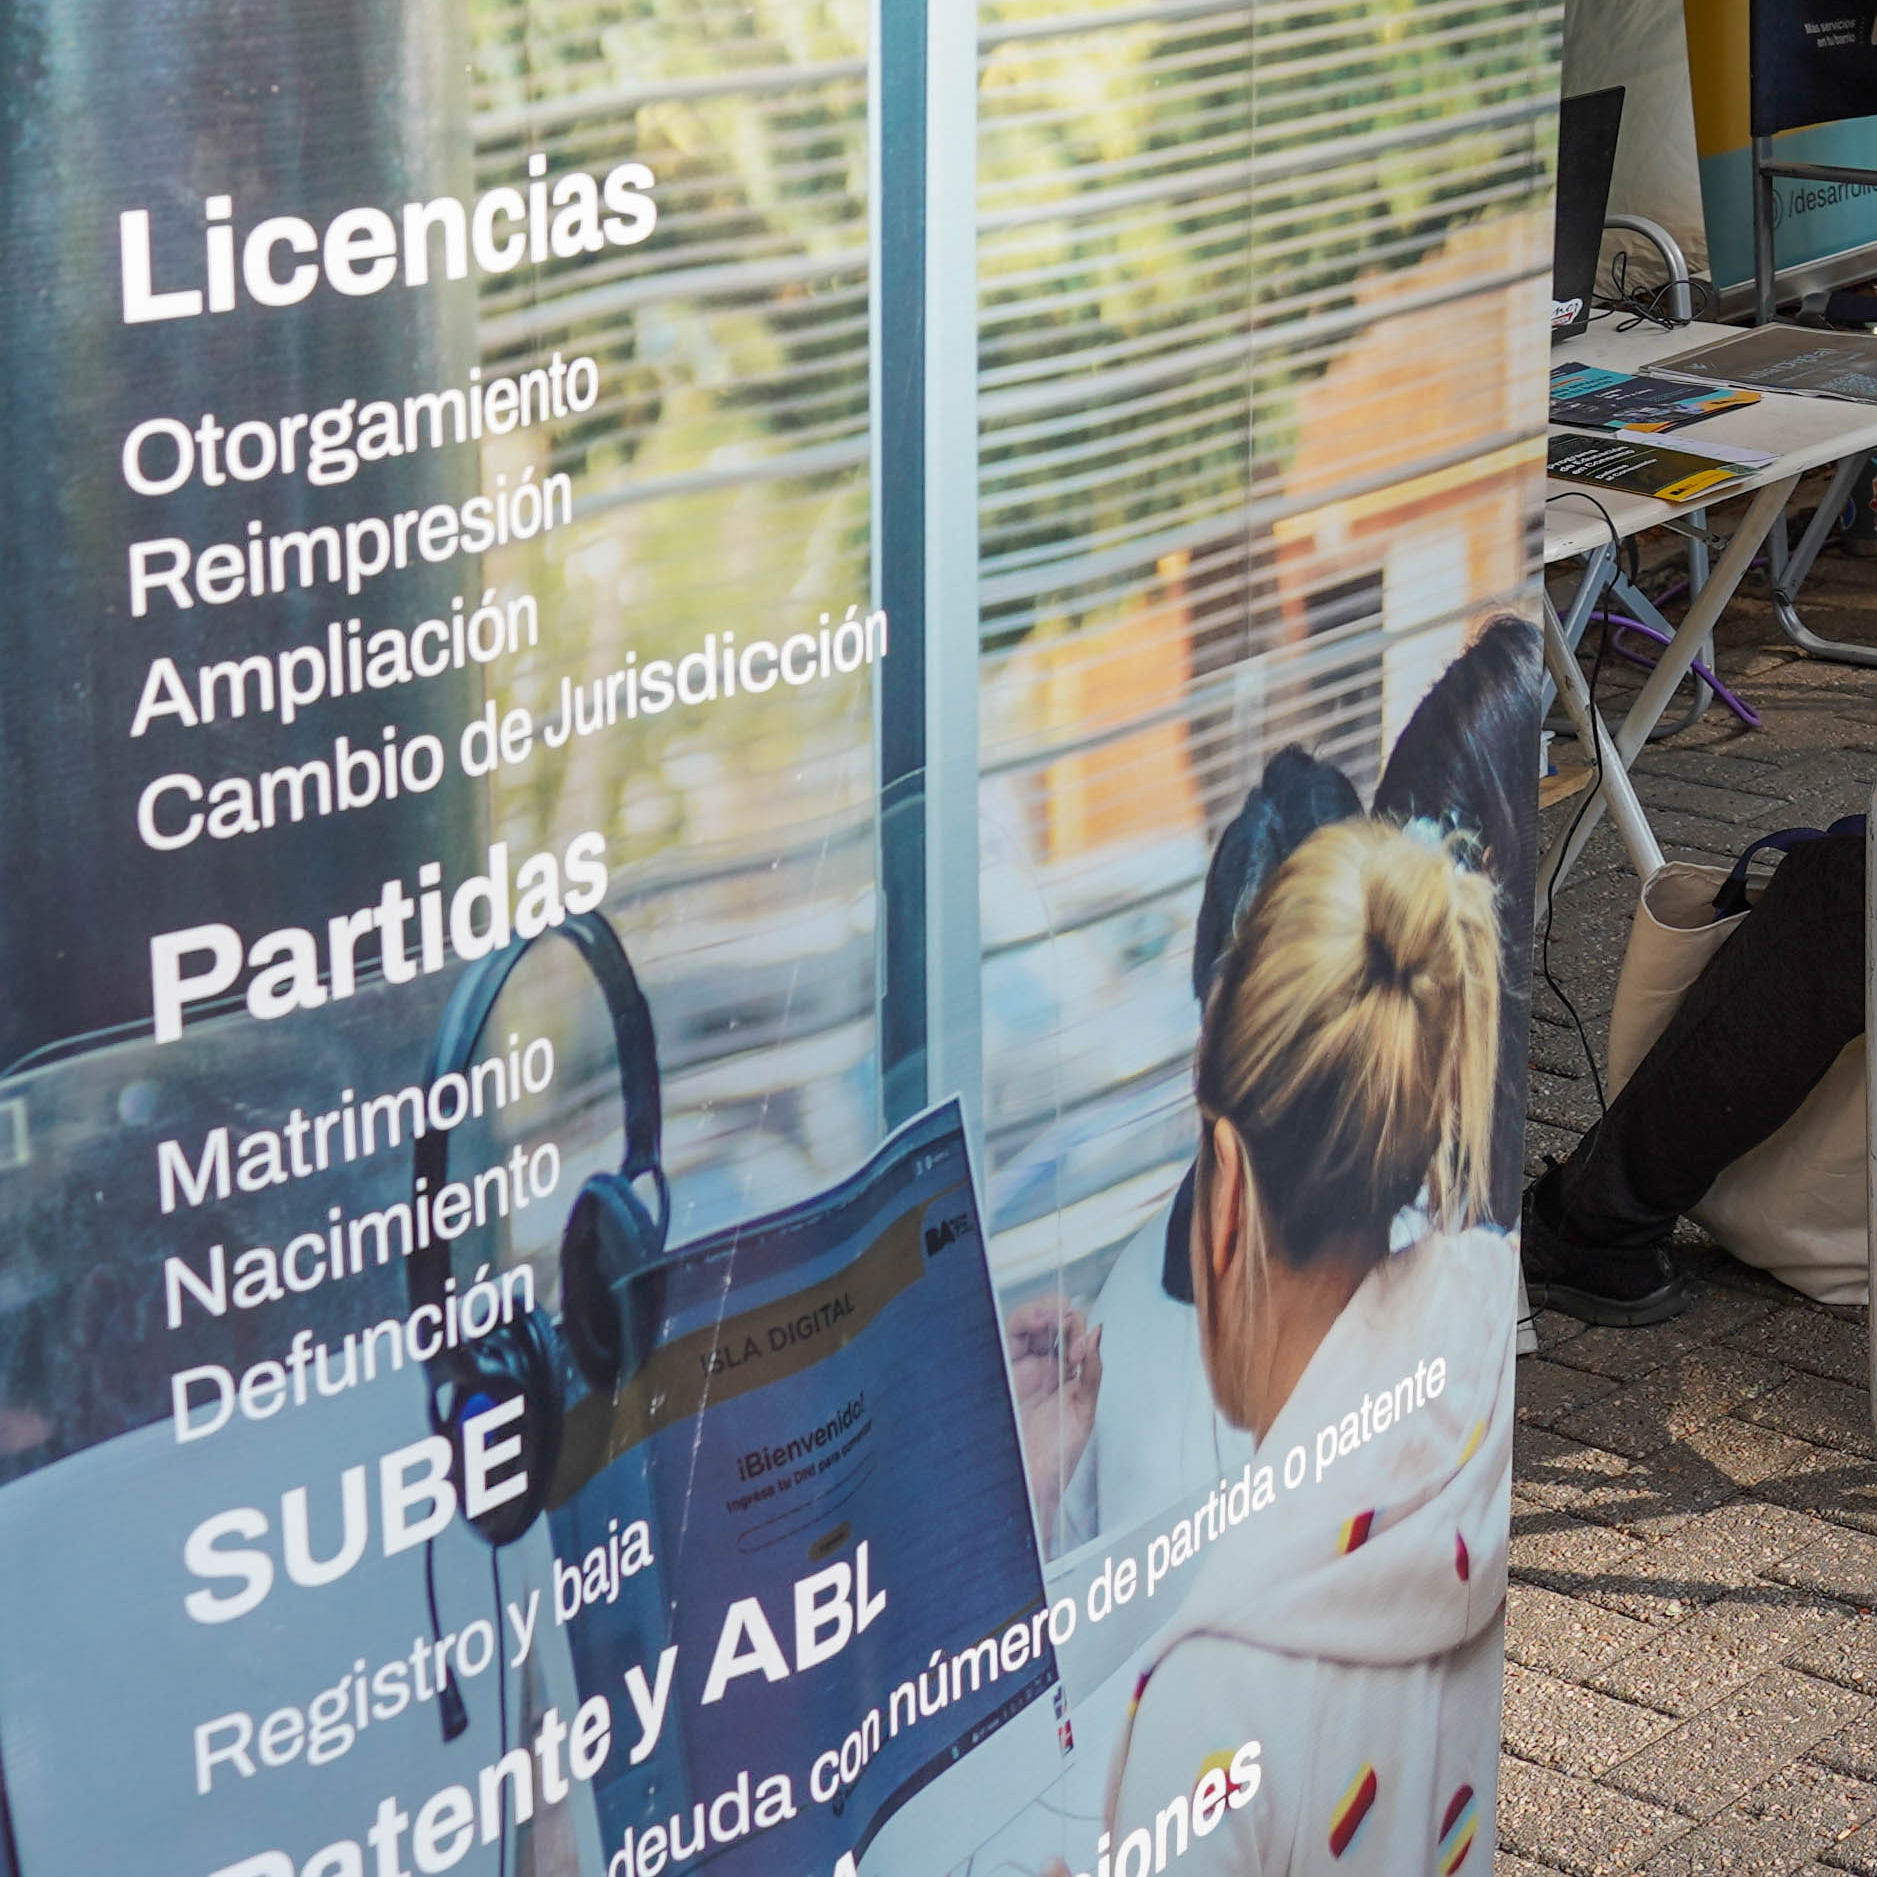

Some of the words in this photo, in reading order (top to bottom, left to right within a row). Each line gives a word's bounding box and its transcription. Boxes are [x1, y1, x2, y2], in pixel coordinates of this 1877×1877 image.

[118, 153, 659, 324] Licencias
[122, 351, 601, 497] Otorgamiento
[129, 463, 573, 618] Reimpresión
[131, 587, 539, 735] Ampliación
[137, 694, 445, 851] Cambio
[461, 698, 534, 778] de
[543, 604, 889, 752] Jurisdicción
[150, 821, 609, 1046] Partidas
[157, 1031, 556, 1214] Matrimonio
[165, 1140, 562, 1329] Nacimiento
[171, 1259, 535, 1445] Defunción
[700, 1337, 761, 1379] ISLA
[768, 1292, 855, 1352] DIGITAL
[184, 1396, 530, 1625] SUBE
[195, 1619, 494, 1794] Registro
[507, 1589, 540, 1668] y
[553, 1518, 654, 1626] baja
[607, 1772, 796, 1877] deuda
[811, 1710, 880, 1804] con
[889, 1596, 1076, 1737] número
[1088, 1556, 1136, 1623] de
[1147, 1463, 1275, 1599] partida
[1283, 1445, 1306, 1491] o
[1316, 1356, 1446, 1484] patente
[624, 1644, 678, 1766] y
[701, 1539, 886, 1706] ABL
